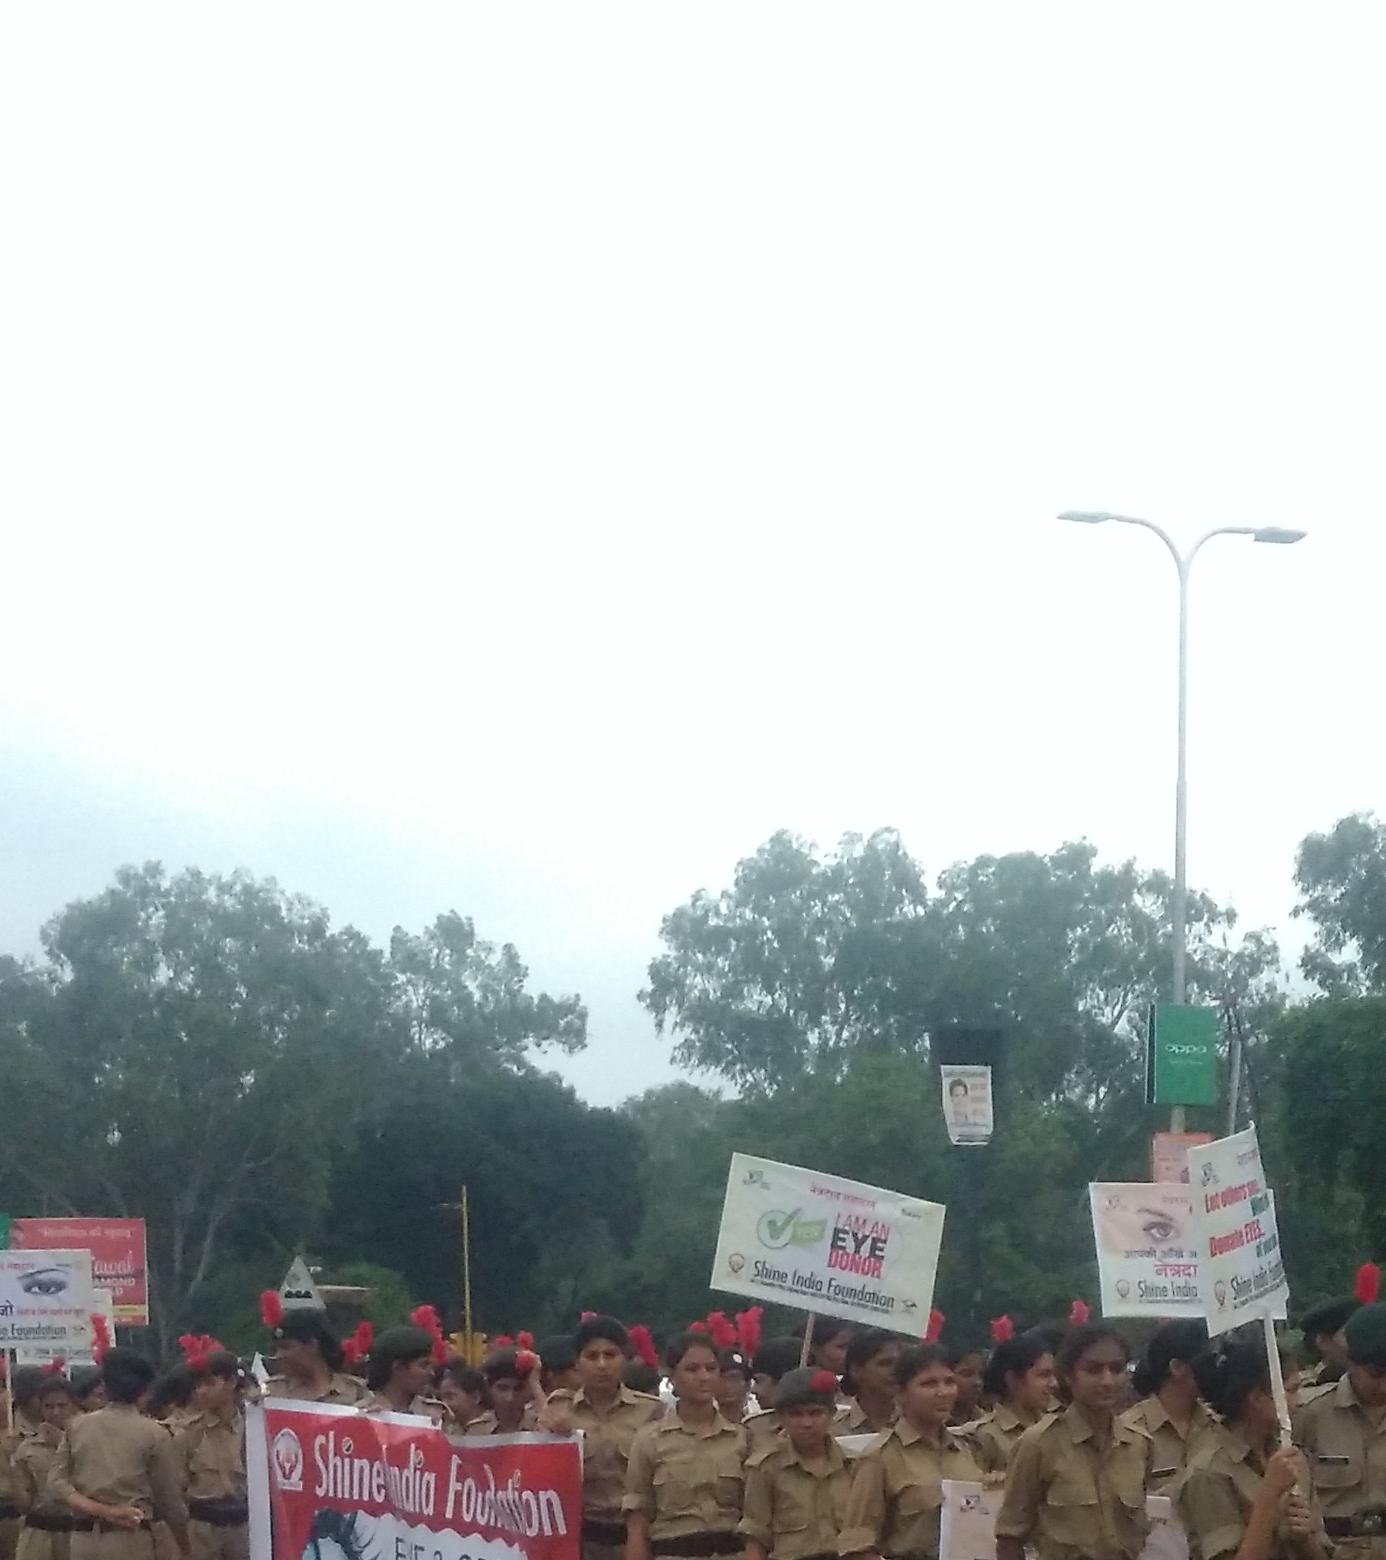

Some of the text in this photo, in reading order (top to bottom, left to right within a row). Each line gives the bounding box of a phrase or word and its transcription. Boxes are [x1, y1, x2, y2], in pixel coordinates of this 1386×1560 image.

[843, 1214, 868, 1233] AM
[869, 1219, 891, 1239] AN
[830, 1227, 888, 1260] EYE
[826, 1248, 883, 1279] DONOR
[752, 1260, 788, 1286] Shine
[791, 1269, 823, 1292] India
[827, 1277, 896, 1309] Foundation
[1137, 1279, 1198, 1298] Shine India
[314, 1430, 387, 1504] Shine
